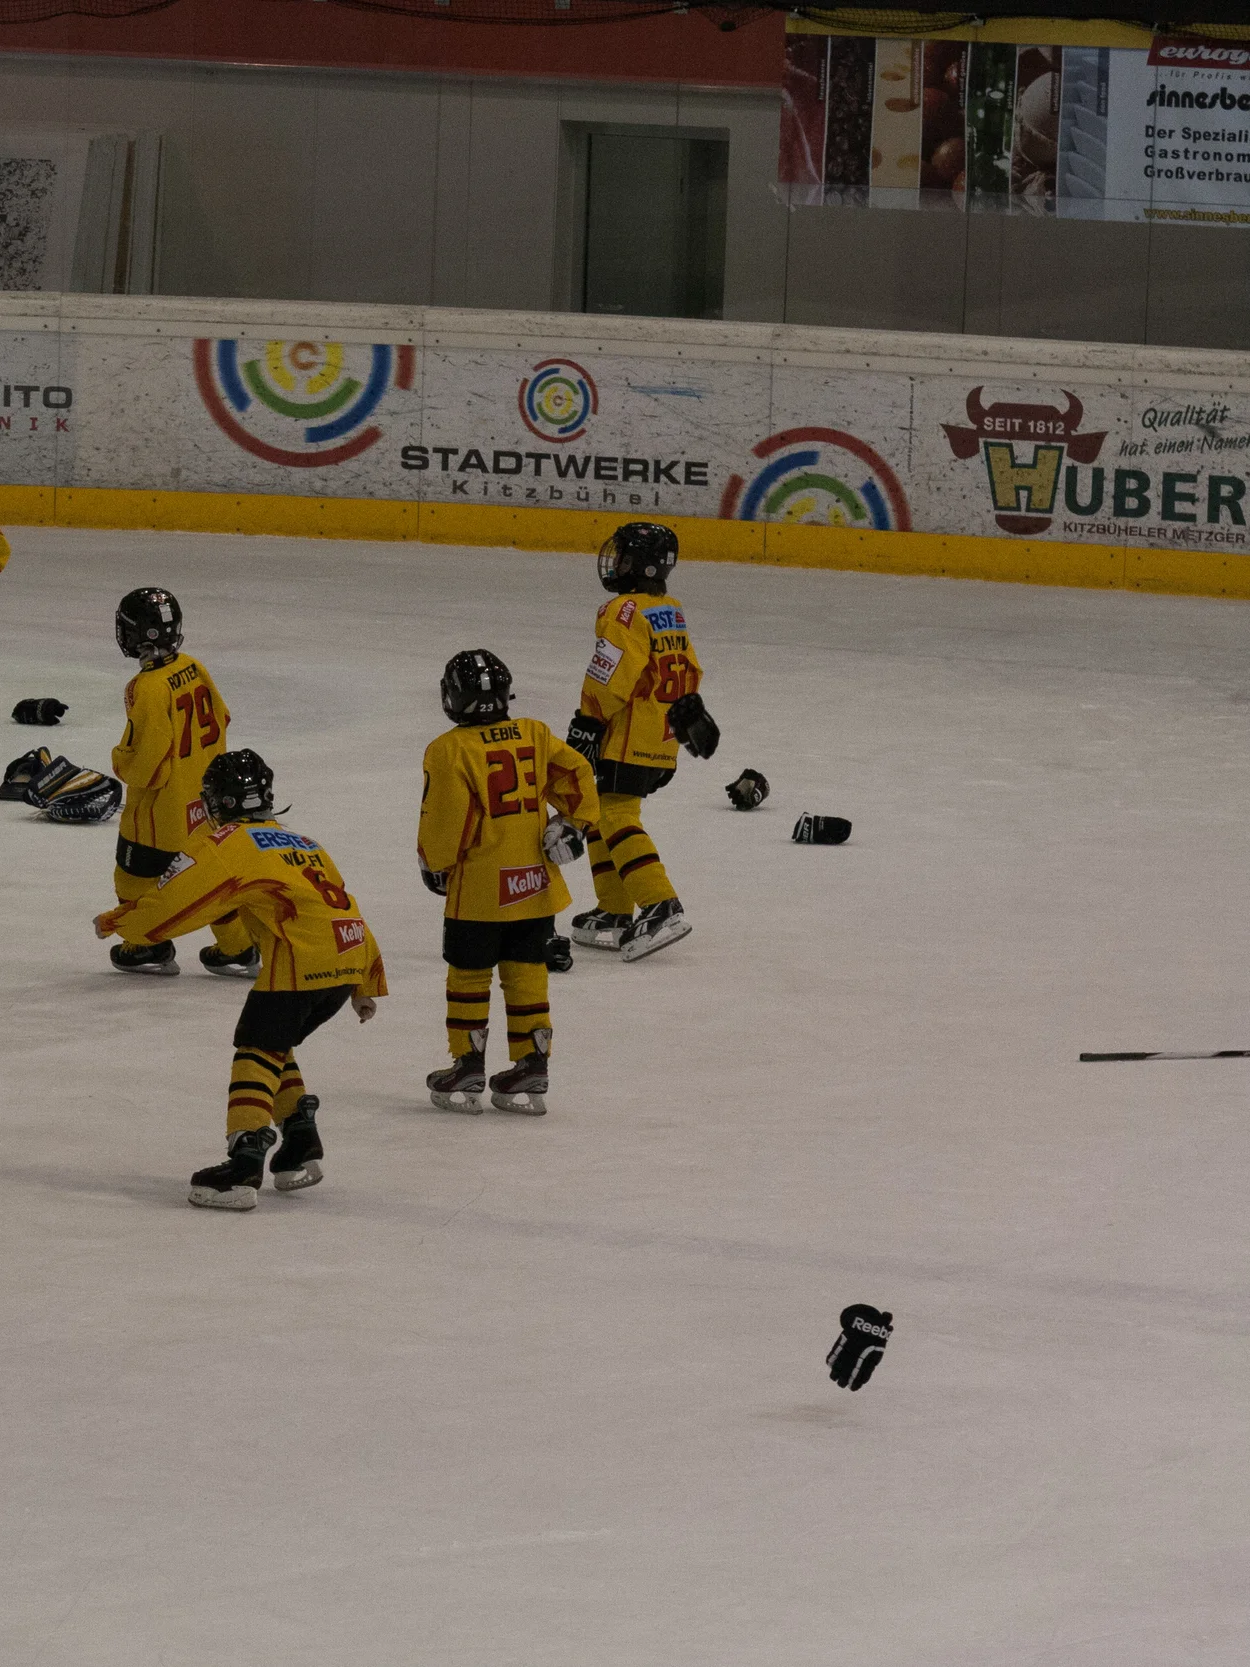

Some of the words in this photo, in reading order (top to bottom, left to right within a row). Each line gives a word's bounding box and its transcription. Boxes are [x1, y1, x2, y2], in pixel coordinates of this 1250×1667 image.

[1159, 45, 1250, 65] eurog
[1193, 71, 1232, 80] Profis
[1145, 125, 1175, 139] Der
[1182, 127, 1249, 143] Speziali
[1145, 145, 1250, 163] Gastronom
[1144, 165, 1250, 183] Großverbrau
[983, 416, 1023, 433] SEIT
[1027, 419, 1066, 435] 1812
[1141, 401, 1231, 432] Qualität
[1119, 440, 1149, 457] hat
[1154, 438, 1194, 455] einen
[400, 445, 710, 487] STADTWERKE
[451, 479, 661, 507] Kitzbühel
[1063, 520, 1168, 539] KITZBÜHELER
[1172, 527, 1246, 544] METZGER
[479, 704, 494, 713] 23
[175, 684, 221, 759] 79
[486, 746, 538, 819] 23
[506, 868, 549, 895] Kelly's
[338, 921, 365, 944] Kelly'
